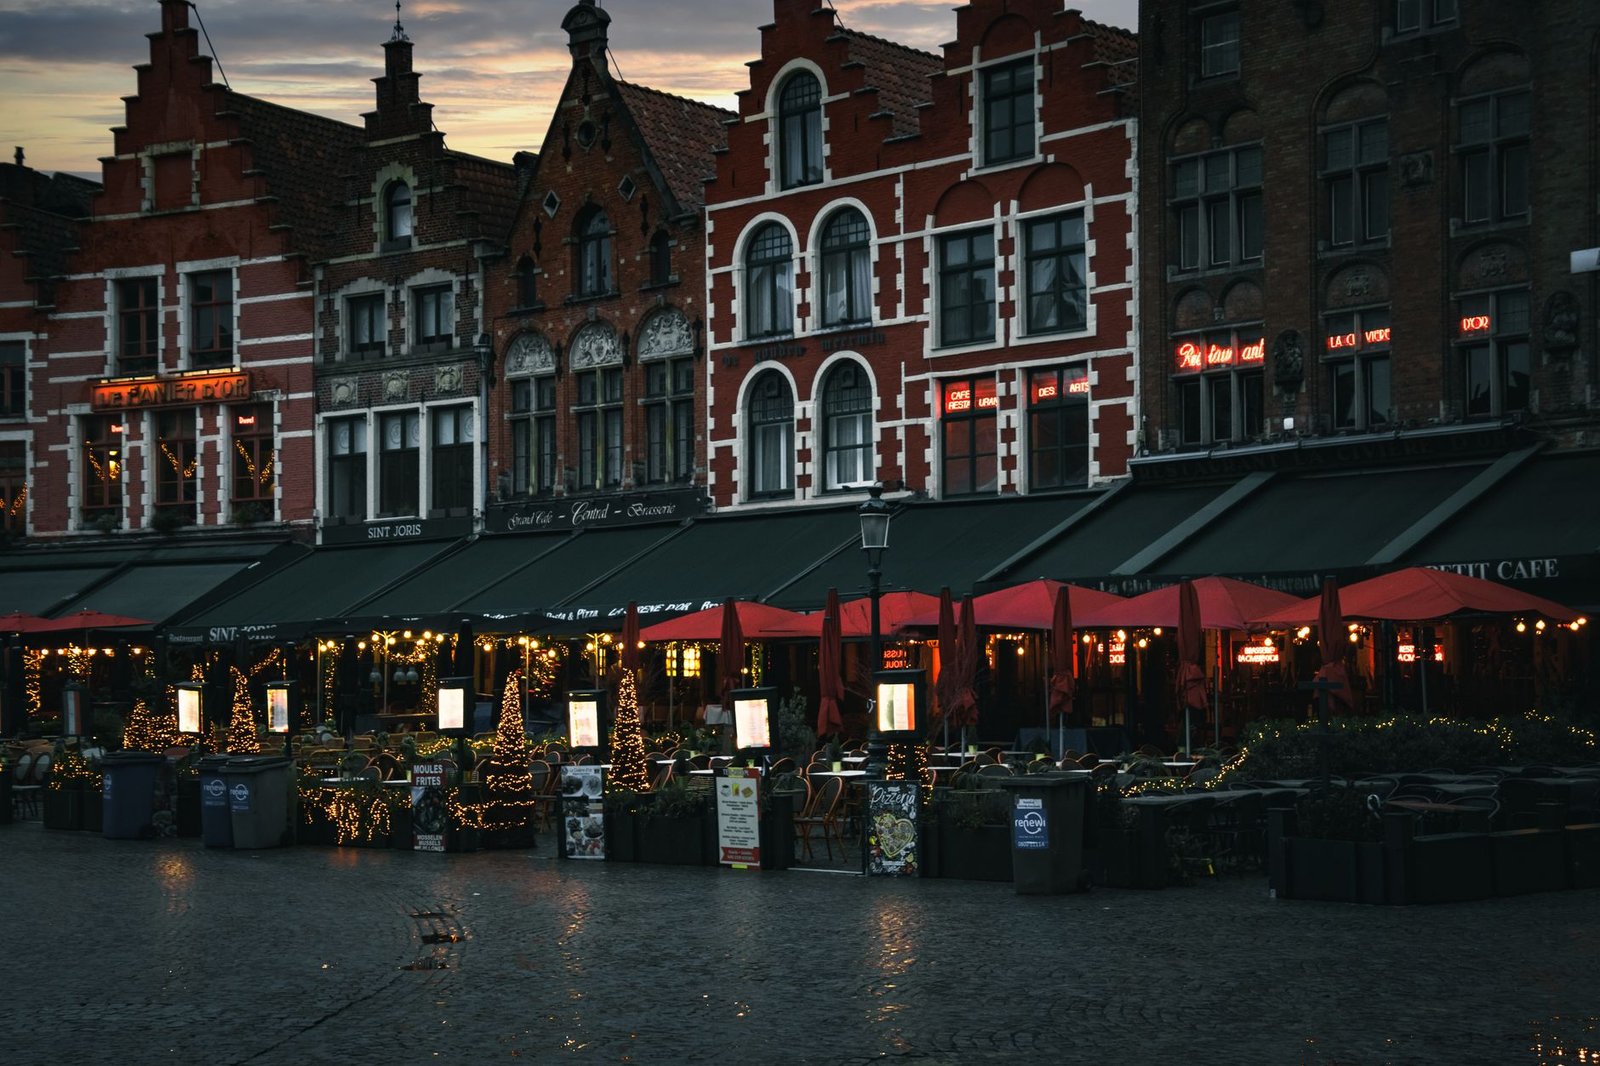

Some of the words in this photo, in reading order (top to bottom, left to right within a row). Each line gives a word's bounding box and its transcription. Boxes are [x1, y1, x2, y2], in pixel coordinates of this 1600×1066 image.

[100, 391, 123, 408] LE
[127, 382, 197, 406] PANIER
[201, 378, 247, 400] D'OR
[571, 501, 610, 526] Central
[626, 502, 677, 518] Brasserie
[367, 526, 391, 539] SINT
[393, 524, 422, 537] JORIS
[1496, 558, 1560, 580] CAFE
[413, 764, 443, 774] MOULES
[416, 776, 441, 786] FRITES
[869, 786, 916, 809] Pizzeria
